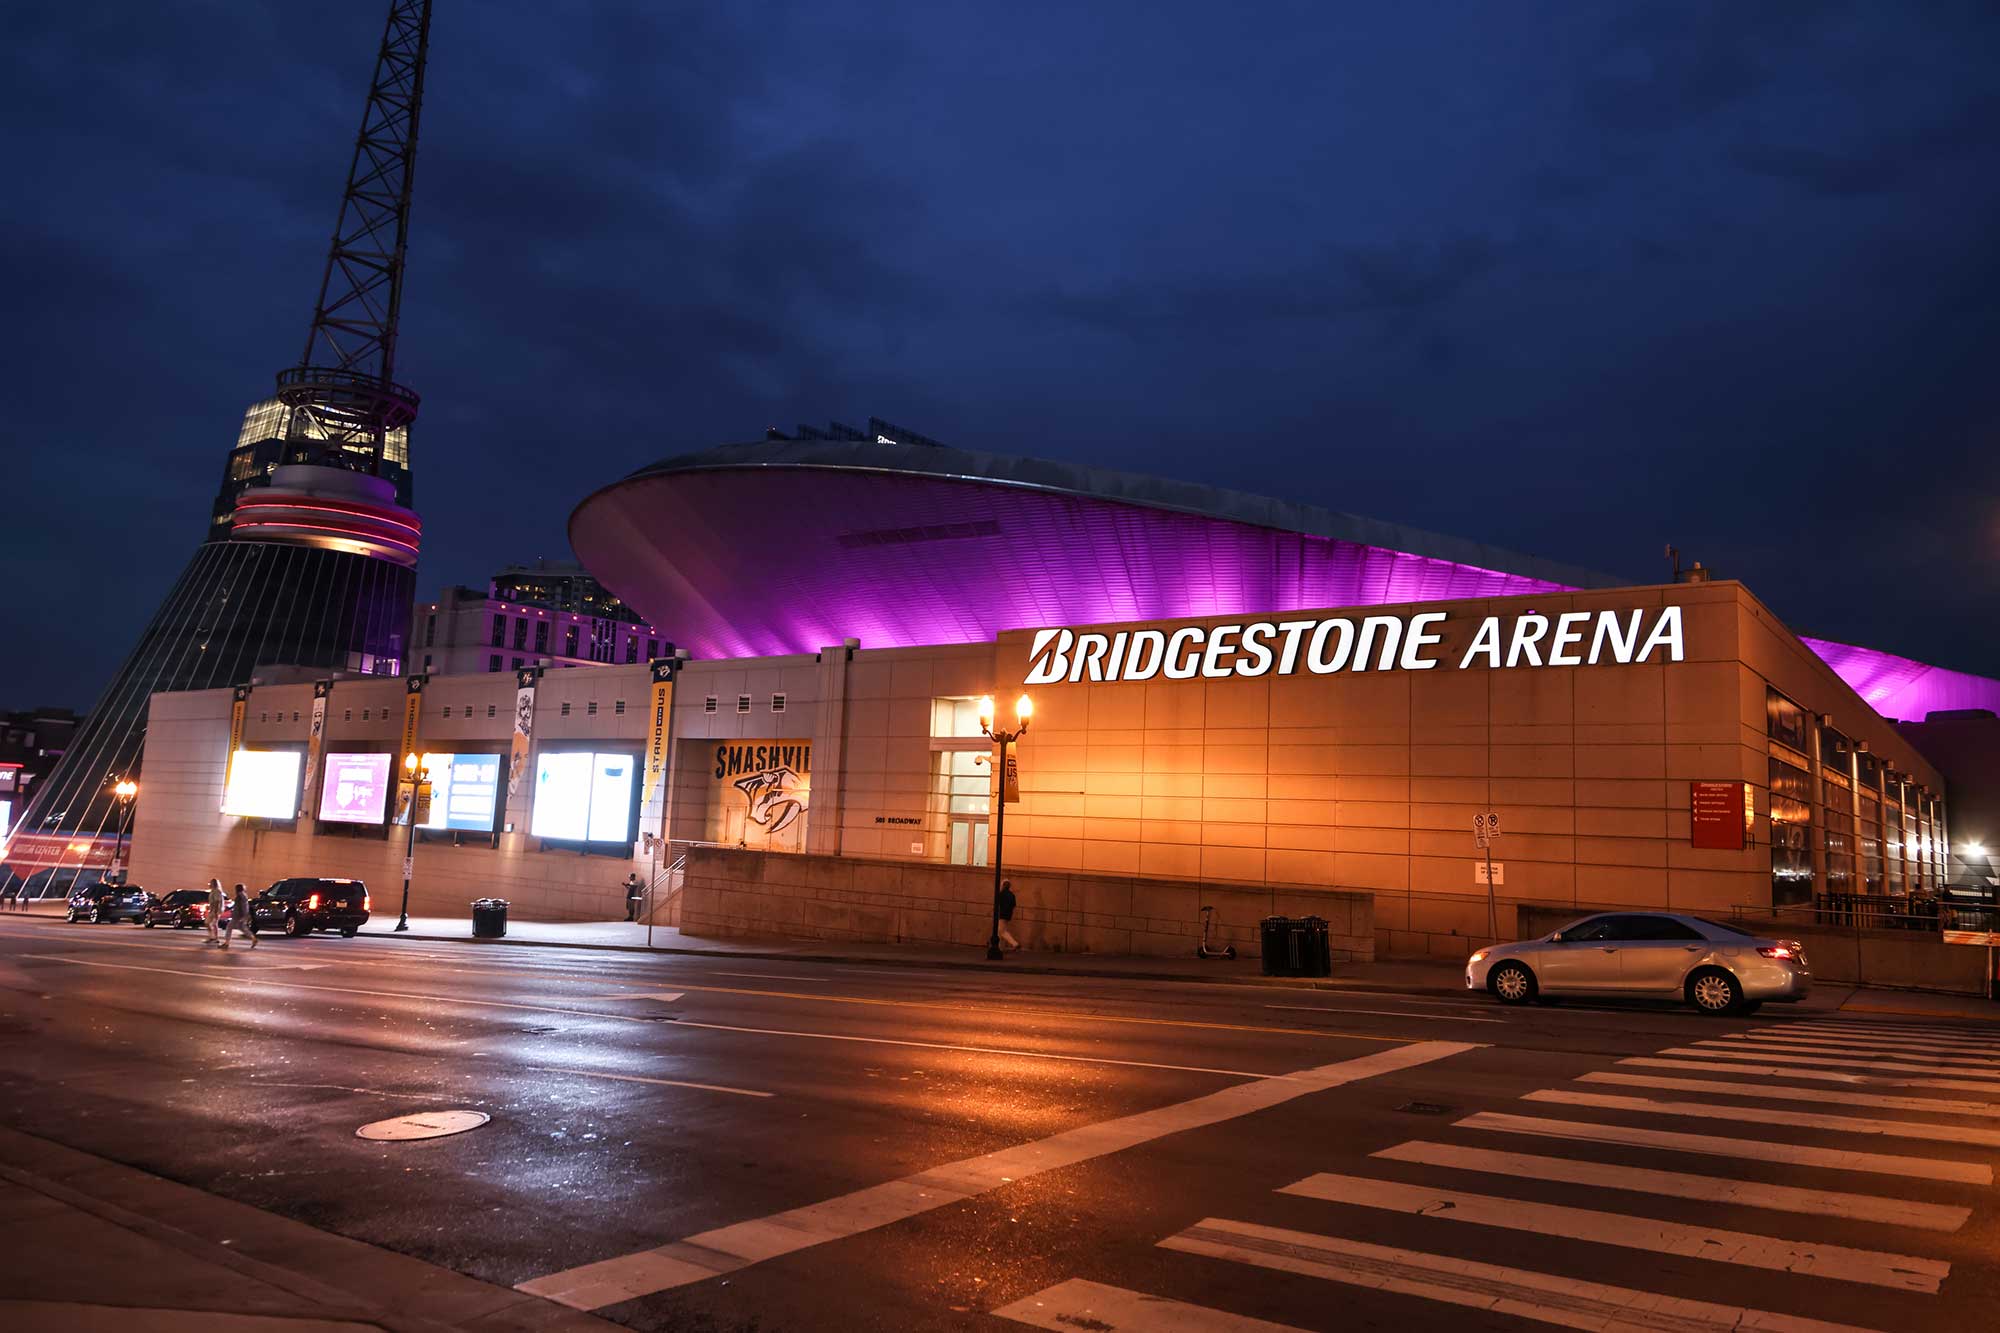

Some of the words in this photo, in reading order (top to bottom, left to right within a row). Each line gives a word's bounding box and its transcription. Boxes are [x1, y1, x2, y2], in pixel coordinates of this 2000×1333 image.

[1022, 611, 1448, 685] BRIDGESTONE
[1458, 605, 1685, 670] ARENA
[652, 727, 663, 773] STAND
[658, 688, 666, 706] US
[1007, 767, 1018, 778] US
[887, 817, 922, 825] BROADWAY
